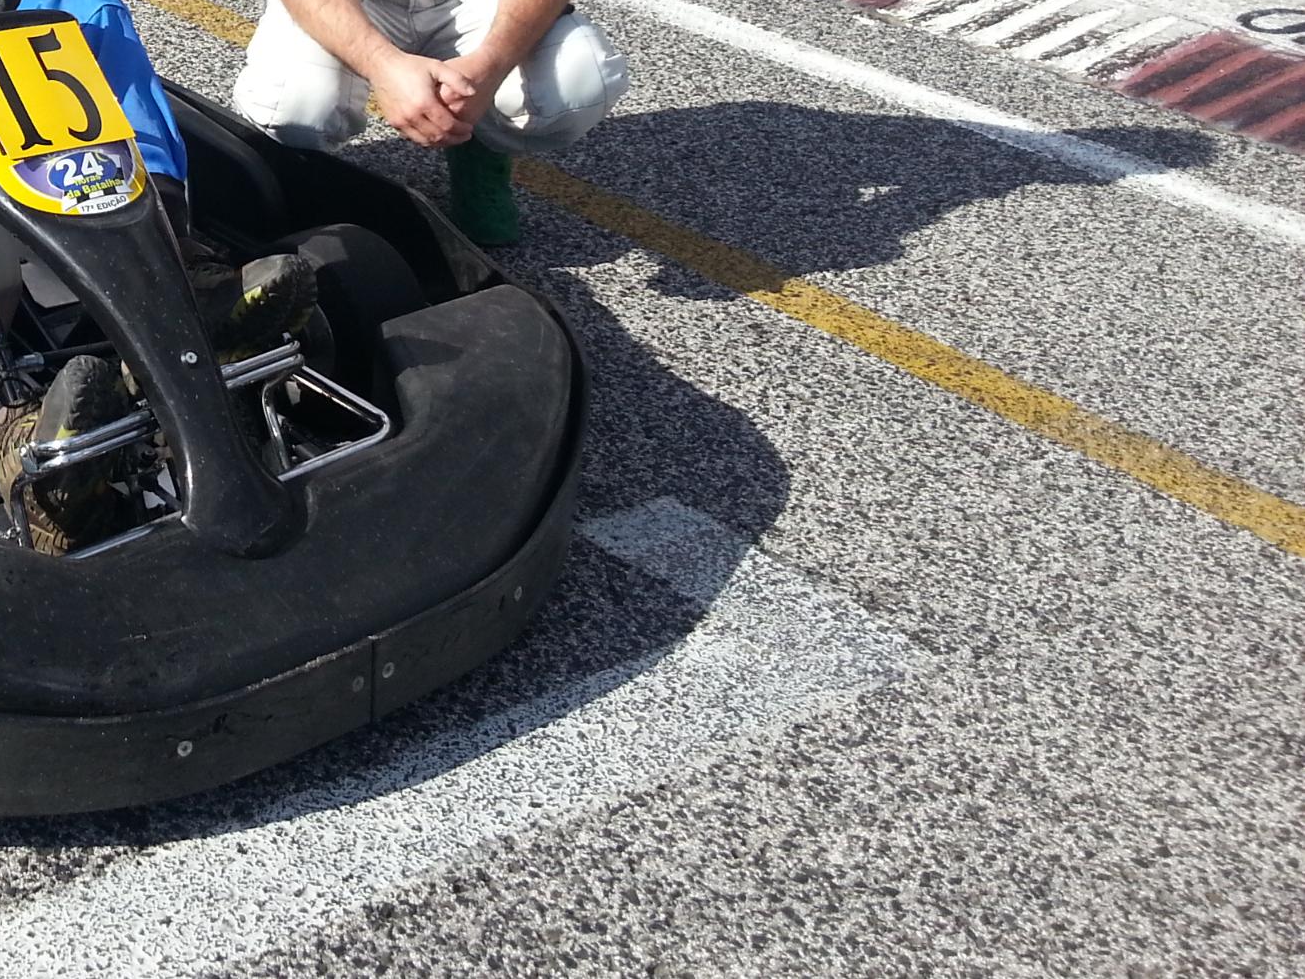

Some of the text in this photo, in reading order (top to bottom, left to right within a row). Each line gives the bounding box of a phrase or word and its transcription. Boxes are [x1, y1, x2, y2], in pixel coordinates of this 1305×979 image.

[55, 152, 105, 187] 24
[81, 178, 124, 194] Batalha
[96, 194, 127, 211] EDIÇÃO
